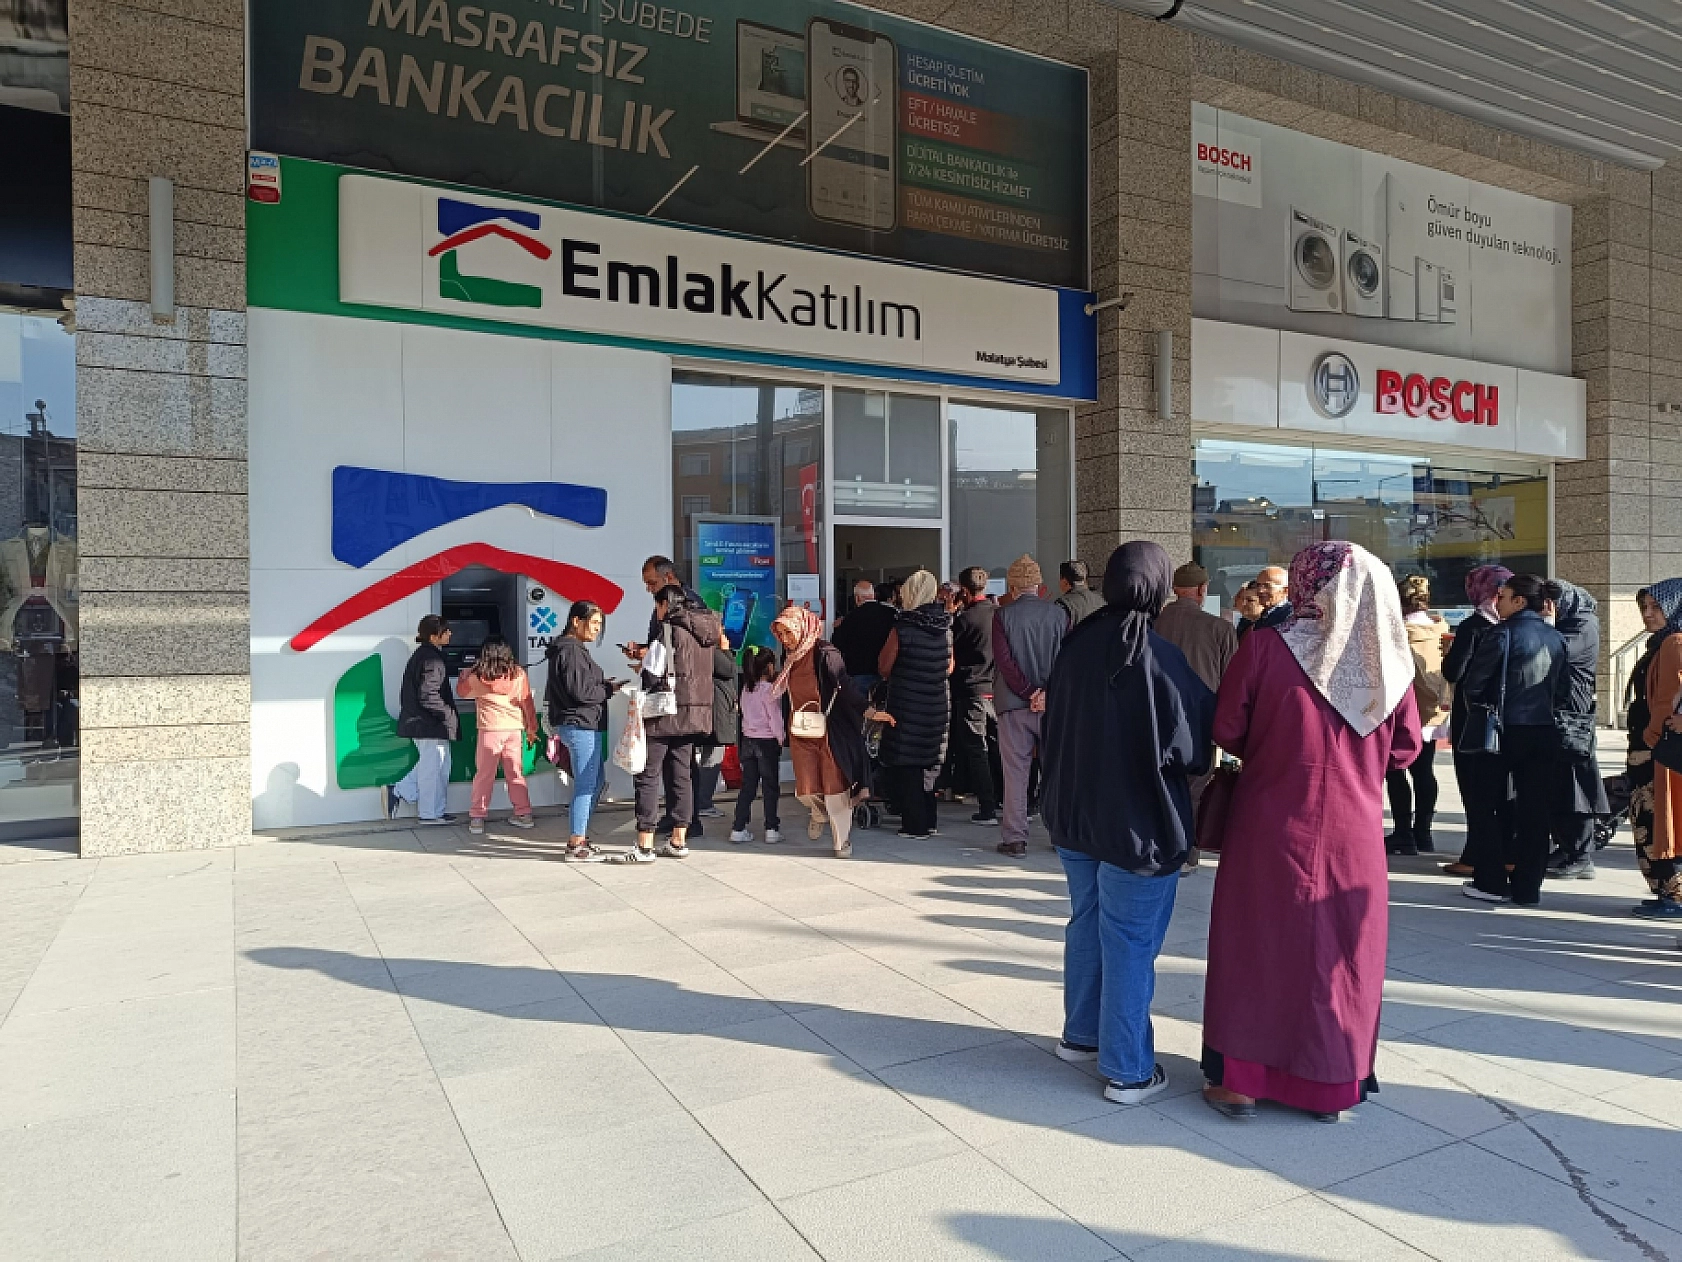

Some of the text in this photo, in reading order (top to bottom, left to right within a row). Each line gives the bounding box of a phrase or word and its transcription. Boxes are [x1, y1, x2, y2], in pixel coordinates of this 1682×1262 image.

[599, 0, 713, 43] ŞUBEDE
[367, 0, 650, 84] MASRAFSIZ
[906, 53, 985, 85] HESAP İŞLETİM
[908, 69, 970, 98] ÜCRETİ YOK
[299, 34, 675, 159] BANKACILIK
[908, 97, 929, 112] EFT
[936, 103, 978, 124] HAVALE
[908, 111, 960, 138] ÜCRETSİZ
[947, 153, 1006, 178] BANKACILIK
[1197, 142, 1252, 172] BOSCH
[933, 166, 991, 191] KESİNTİSİZ
[991, 179, 1032, 199] HİZMET
[906, 209, 934, 227] PARA
[1427, 194, 1492, 229] Ömür boyu
[1427, 220, 1562, 266] güven duyulan teknoloji.
[561, 238, 921, 340] EmlakKatılım
[1375, 369, 1499, 427] BOSCH
